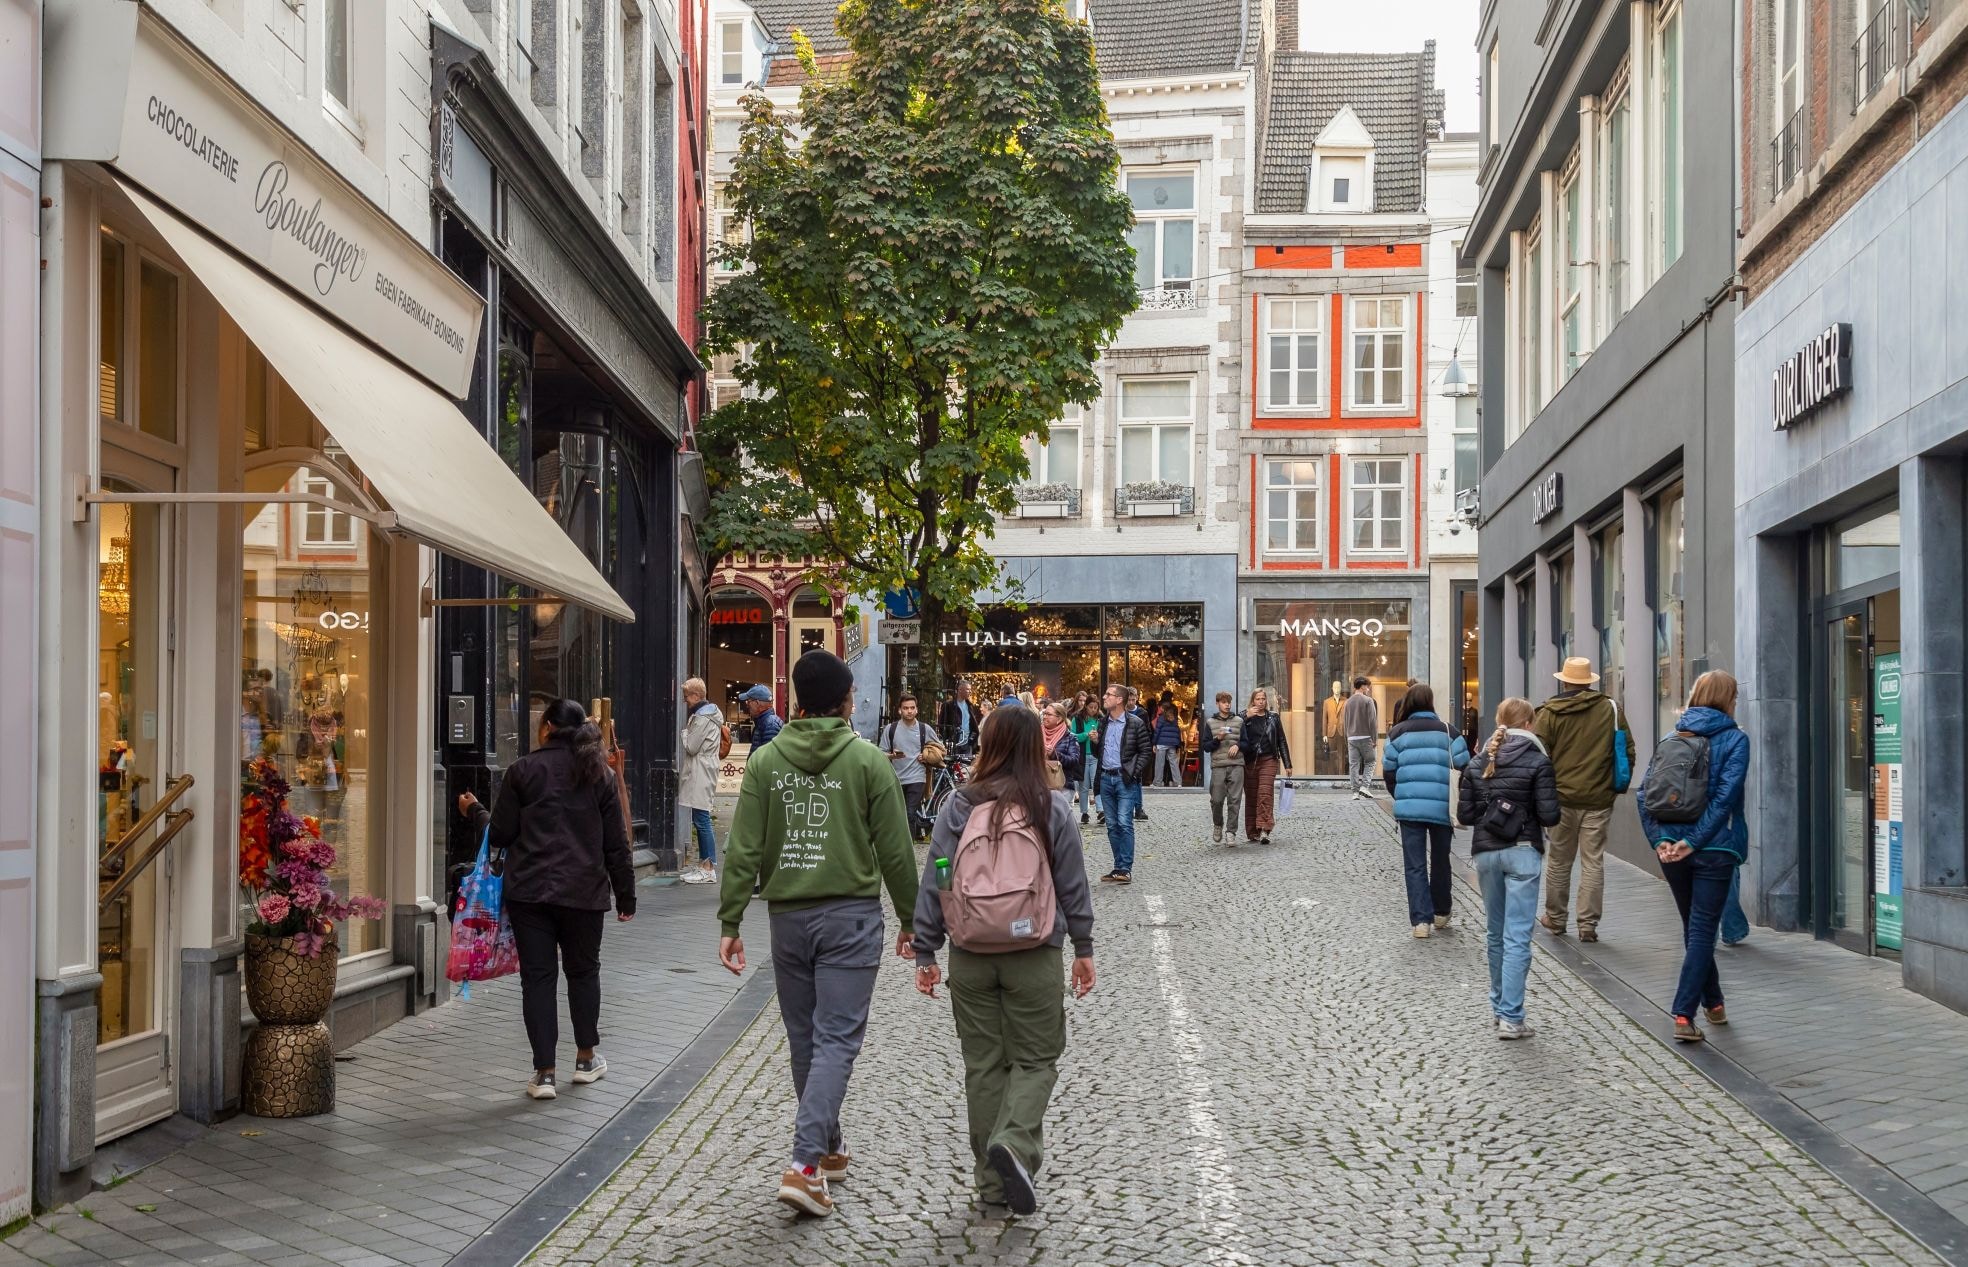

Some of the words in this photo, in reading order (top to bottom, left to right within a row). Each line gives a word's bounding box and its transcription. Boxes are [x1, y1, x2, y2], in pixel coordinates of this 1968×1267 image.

[148, 95, 239, 184] CHOCOLATERIE
[375, 271, 399, 305] EIGEN
[398, 289, 435, 332] FABRIKAAT
[434, 317, 465, 355] BONBONS
[1772, 321, 1840, 432] DURLINGER
[942, 631, 1061, 647] ITUALS...
[1280, 618, 1383, 637] MANGO
